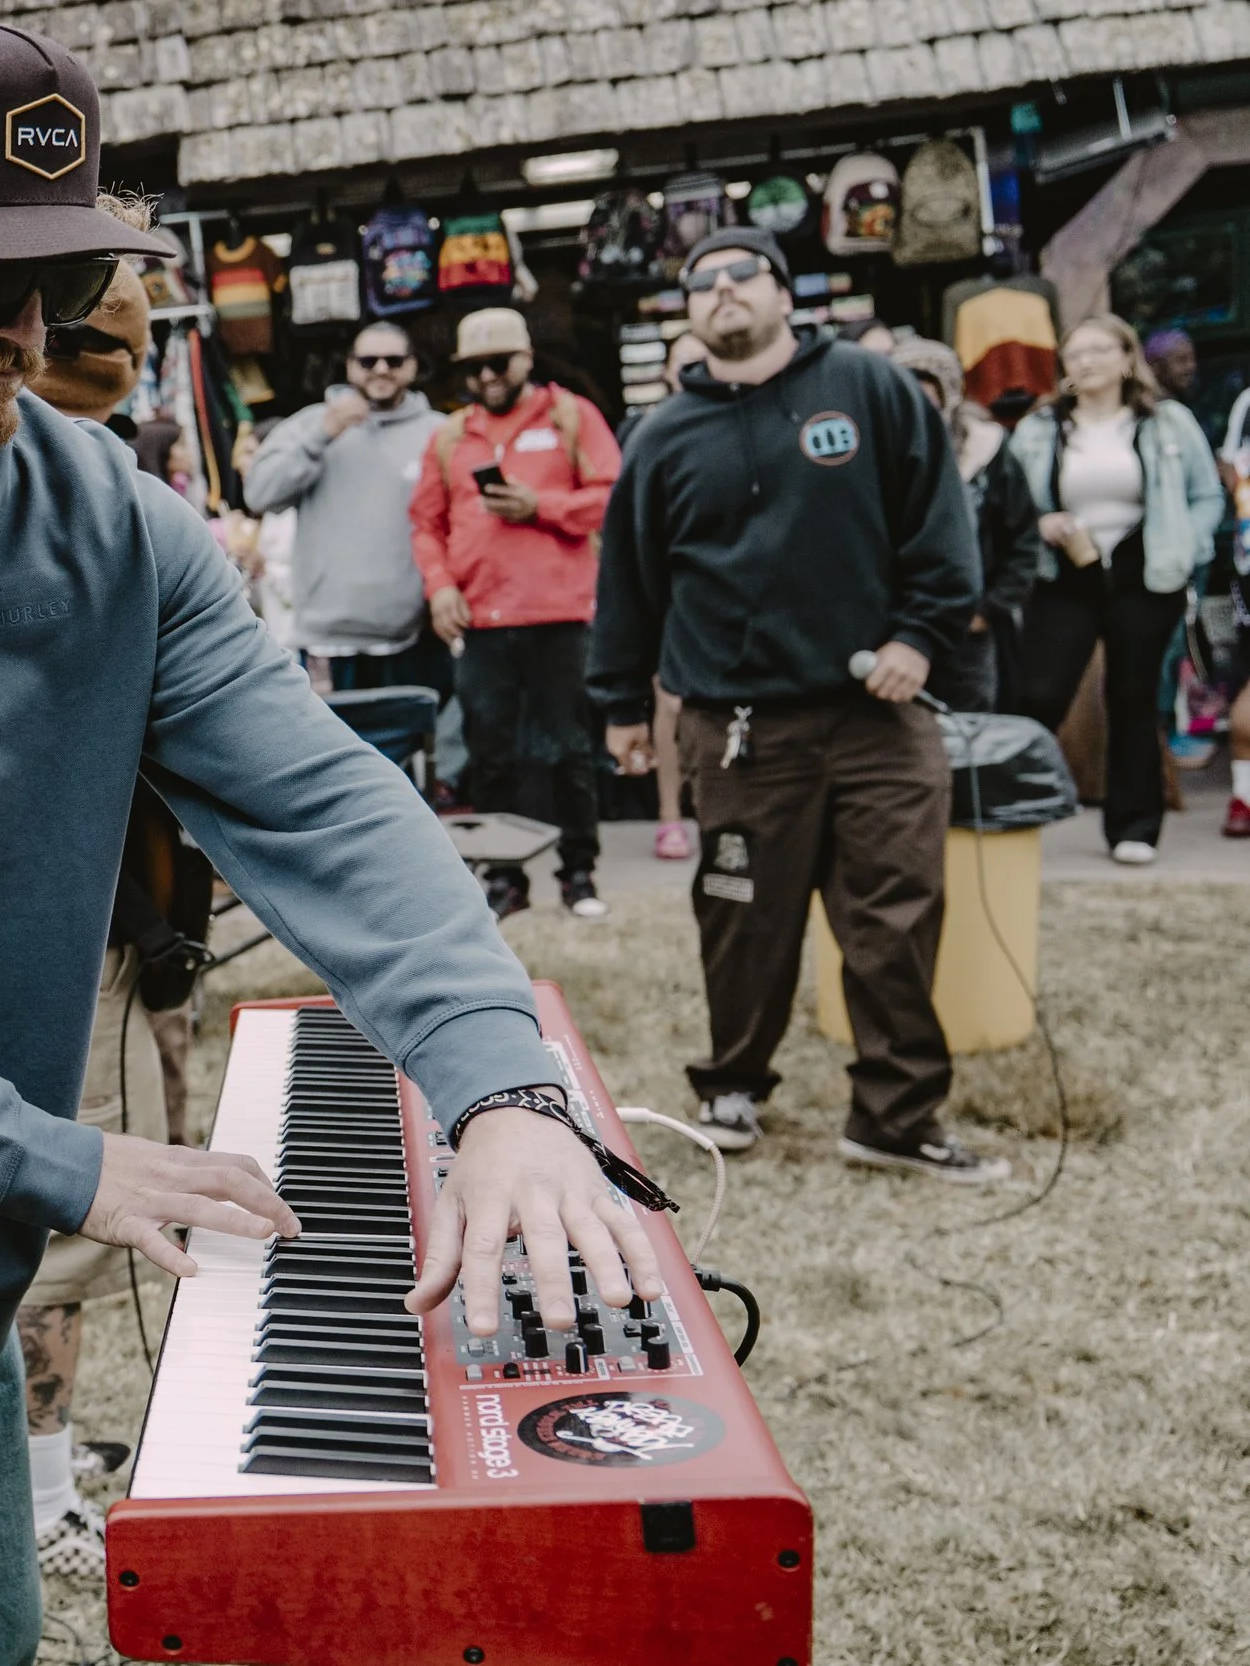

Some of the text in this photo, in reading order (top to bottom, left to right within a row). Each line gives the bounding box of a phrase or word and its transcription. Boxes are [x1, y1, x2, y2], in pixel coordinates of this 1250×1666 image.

[17, 127, 78, 147] RVCA
[475, 1394, 519, 1479] nord stage 3
